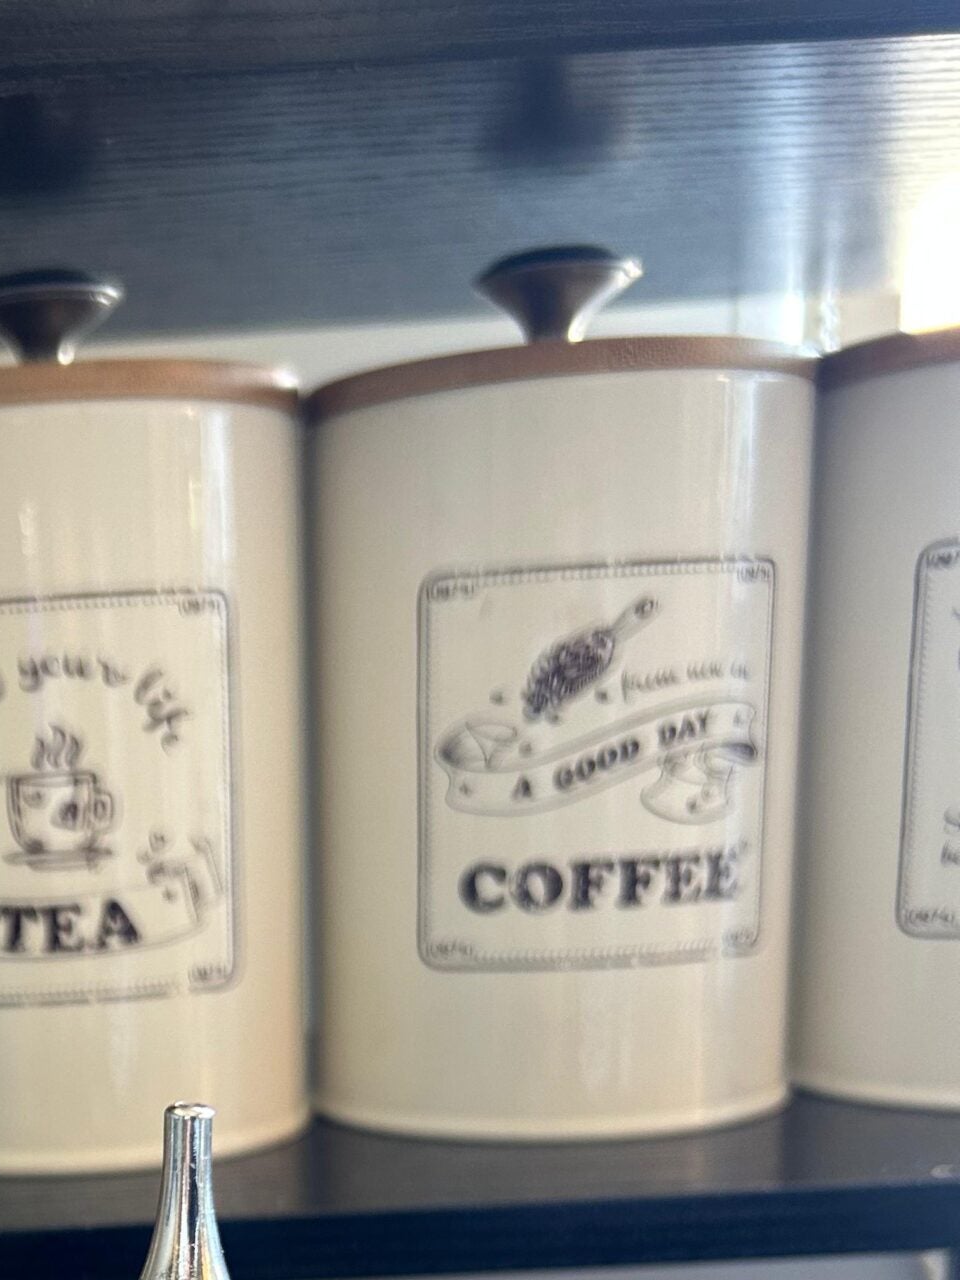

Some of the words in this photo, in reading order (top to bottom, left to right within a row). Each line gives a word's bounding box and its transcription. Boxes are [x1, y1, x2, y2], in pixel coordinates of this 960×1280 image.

[16, 654, 127, 692] your
[512, 774, 533, 800] A
[552, 737, 640, 792] GOOD
[658, 708, 710, 747] DAY
[457, 845, 742, 914] COFFEE
